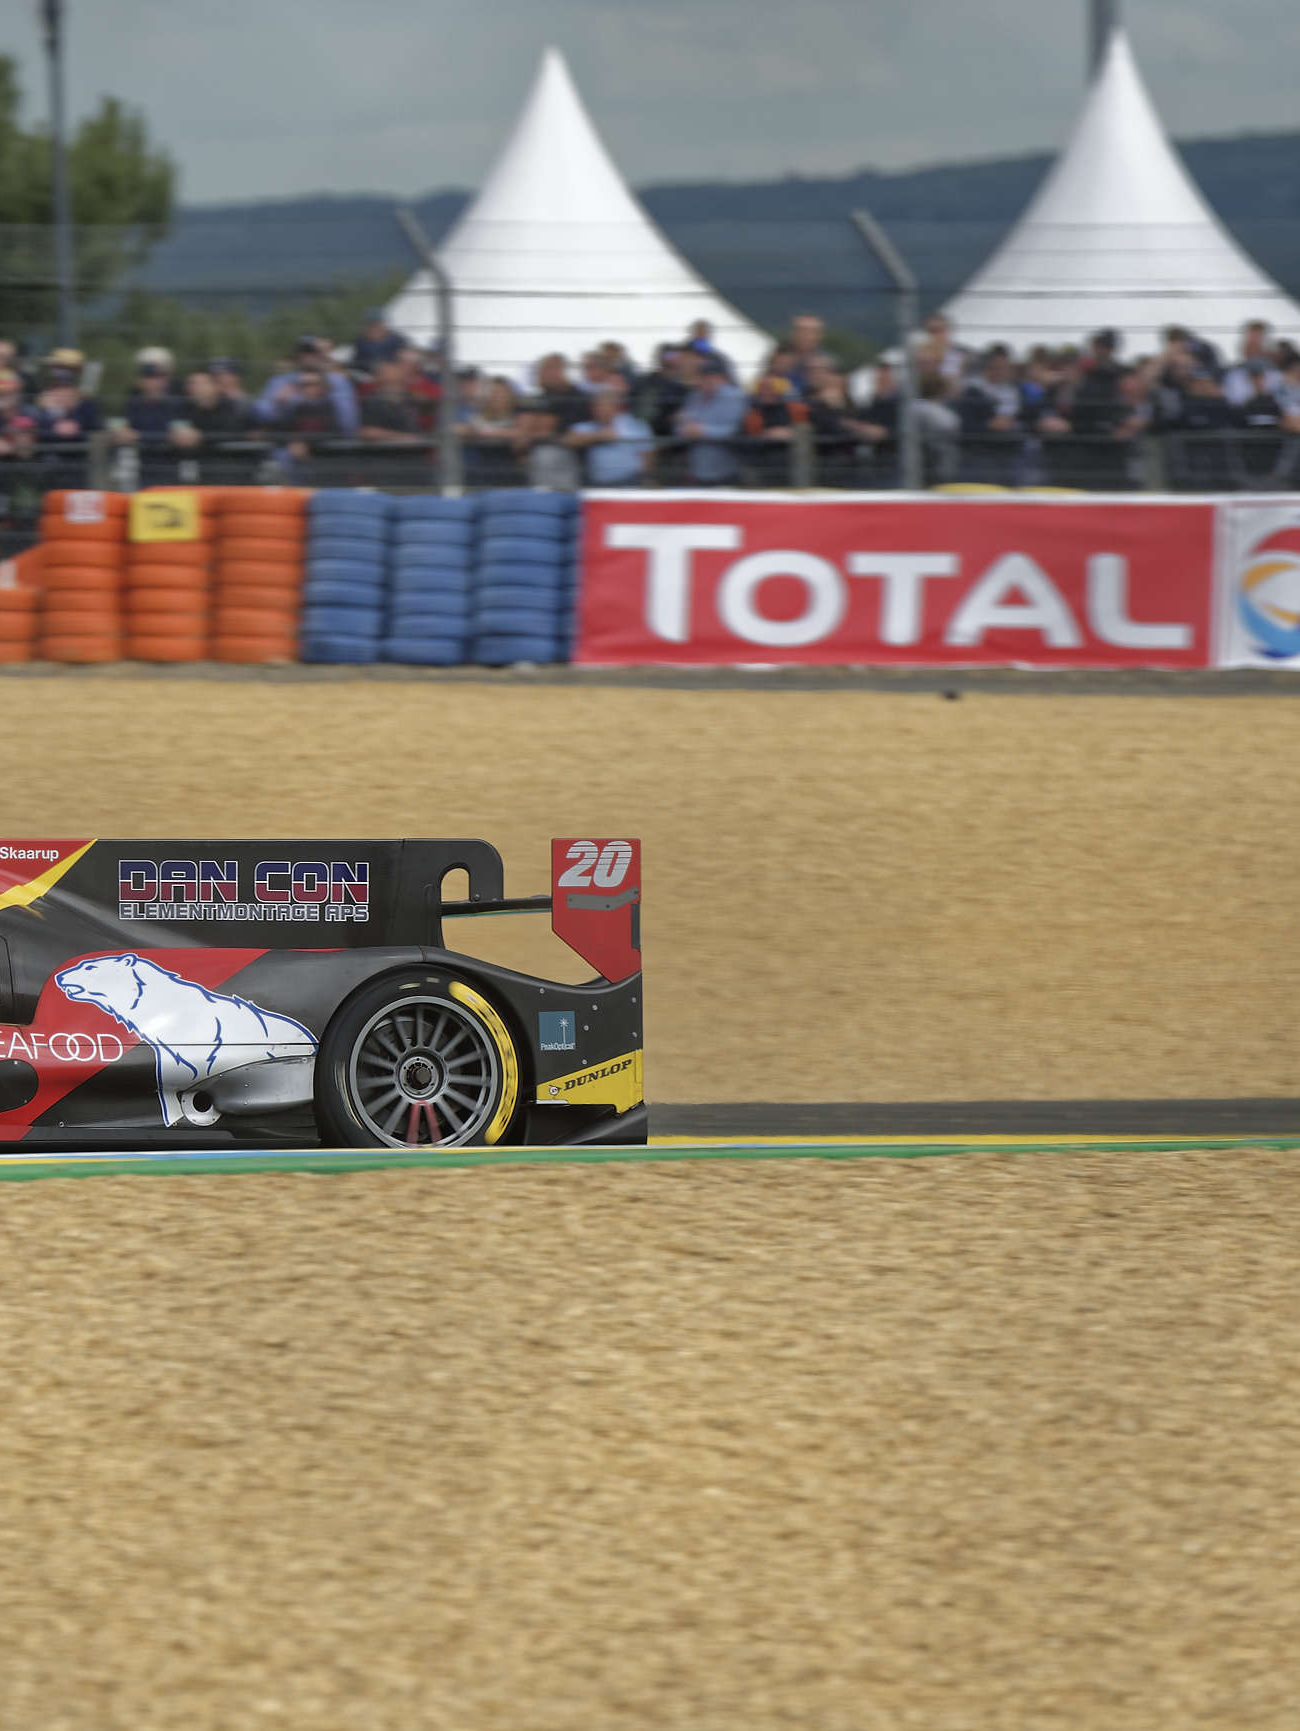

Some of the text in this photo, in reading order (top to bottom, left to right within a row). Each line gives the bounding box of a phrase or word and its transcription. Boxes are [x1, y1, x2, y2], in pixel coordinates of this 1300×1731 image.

[603, 523, 1194, 649] TOTAL
[0, 846, 59, 862] Skaarup
[558, 840, 632, 887] 20
[119, 860, 370, 903] DAN CON
[119, 903, 370, 922] ELEMENTMONTAGE APS
[563, 1059, 632, 1091] DUNLOP
